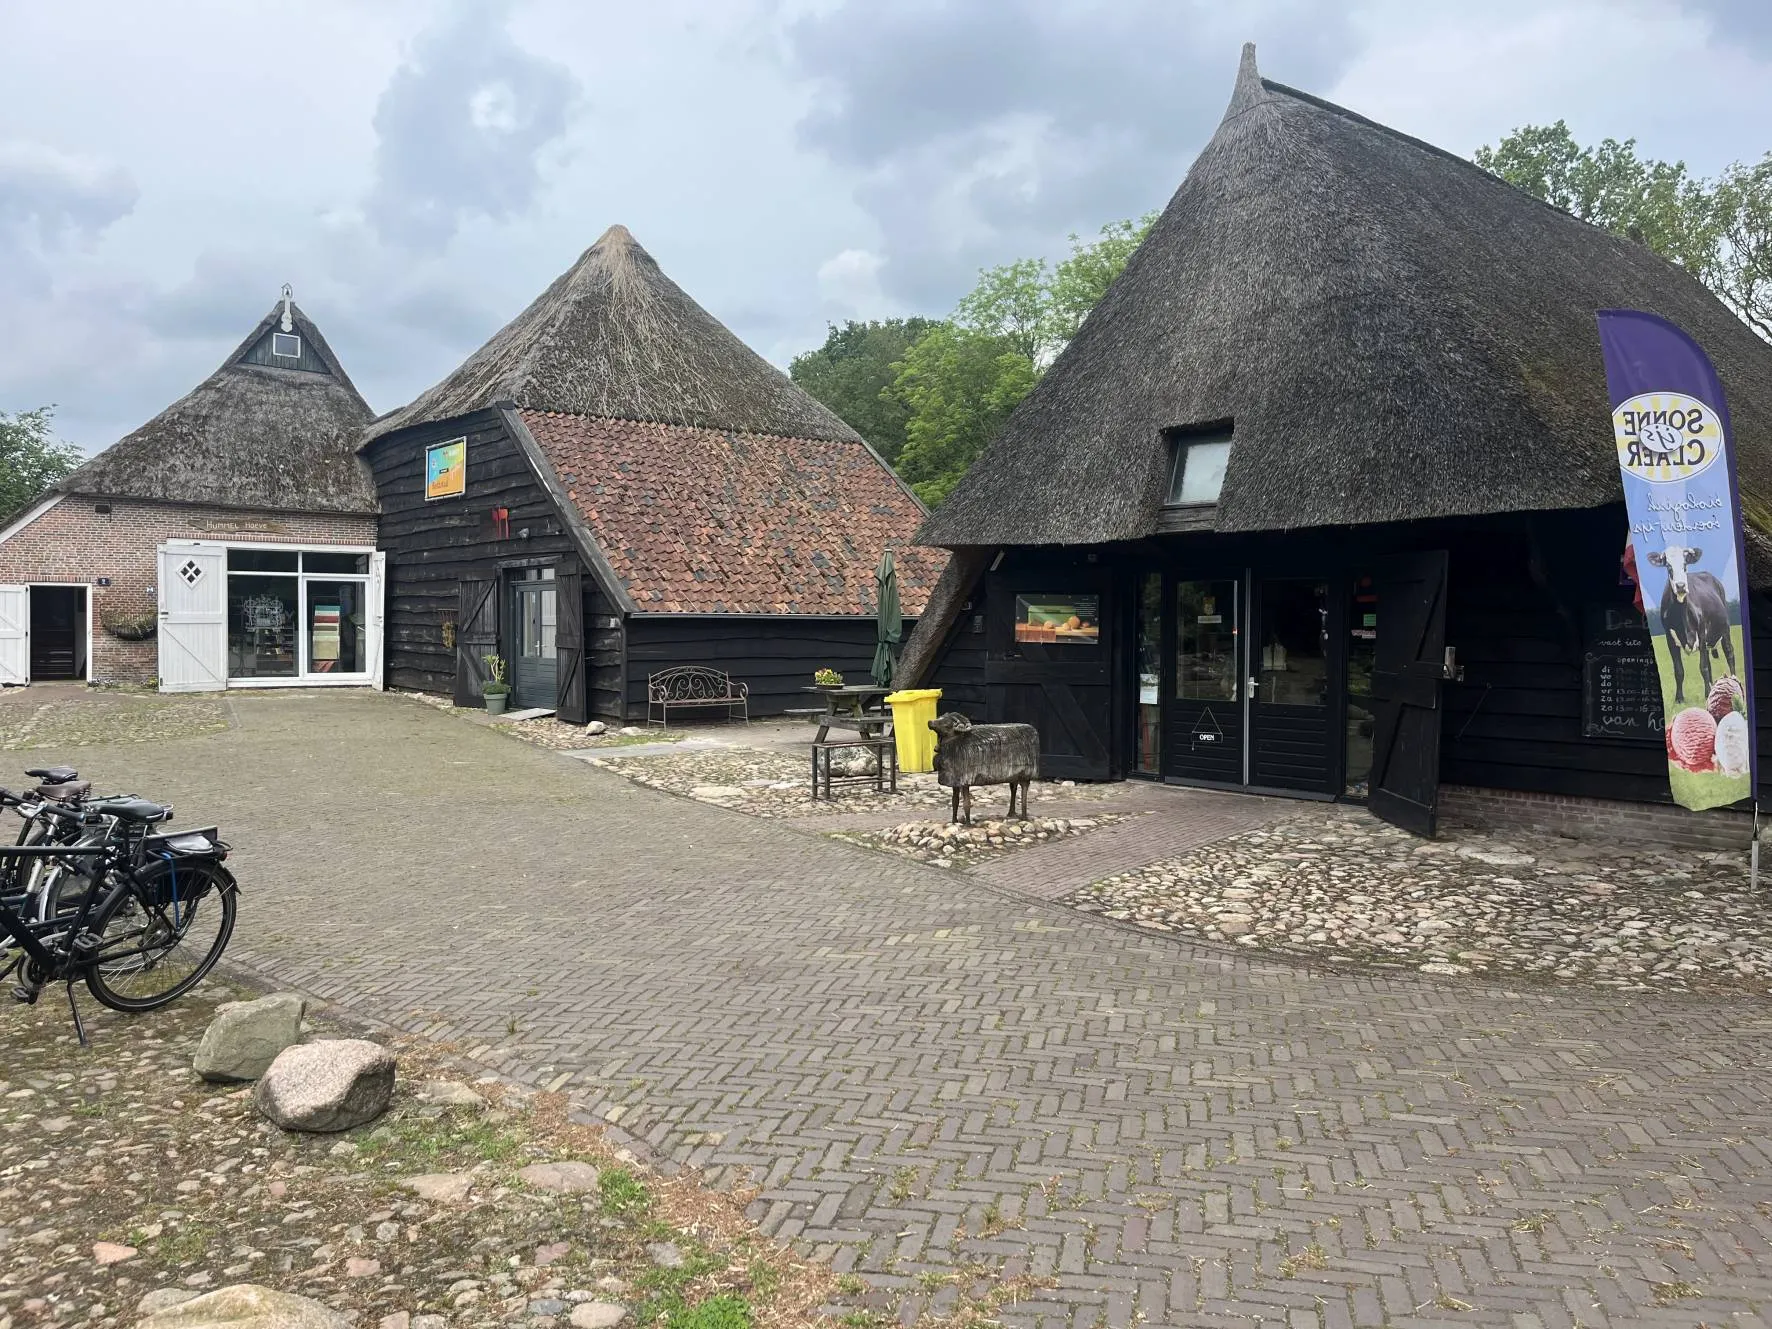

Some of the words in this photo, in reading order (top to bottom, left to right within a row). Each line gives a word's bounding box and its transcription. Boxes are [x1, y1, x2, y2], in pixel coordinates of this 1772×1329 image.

[1601, 665, 1612, 673] di
[1602, 714, 1640, 727] van
[1199, 733, 1215, 741] OPEN
